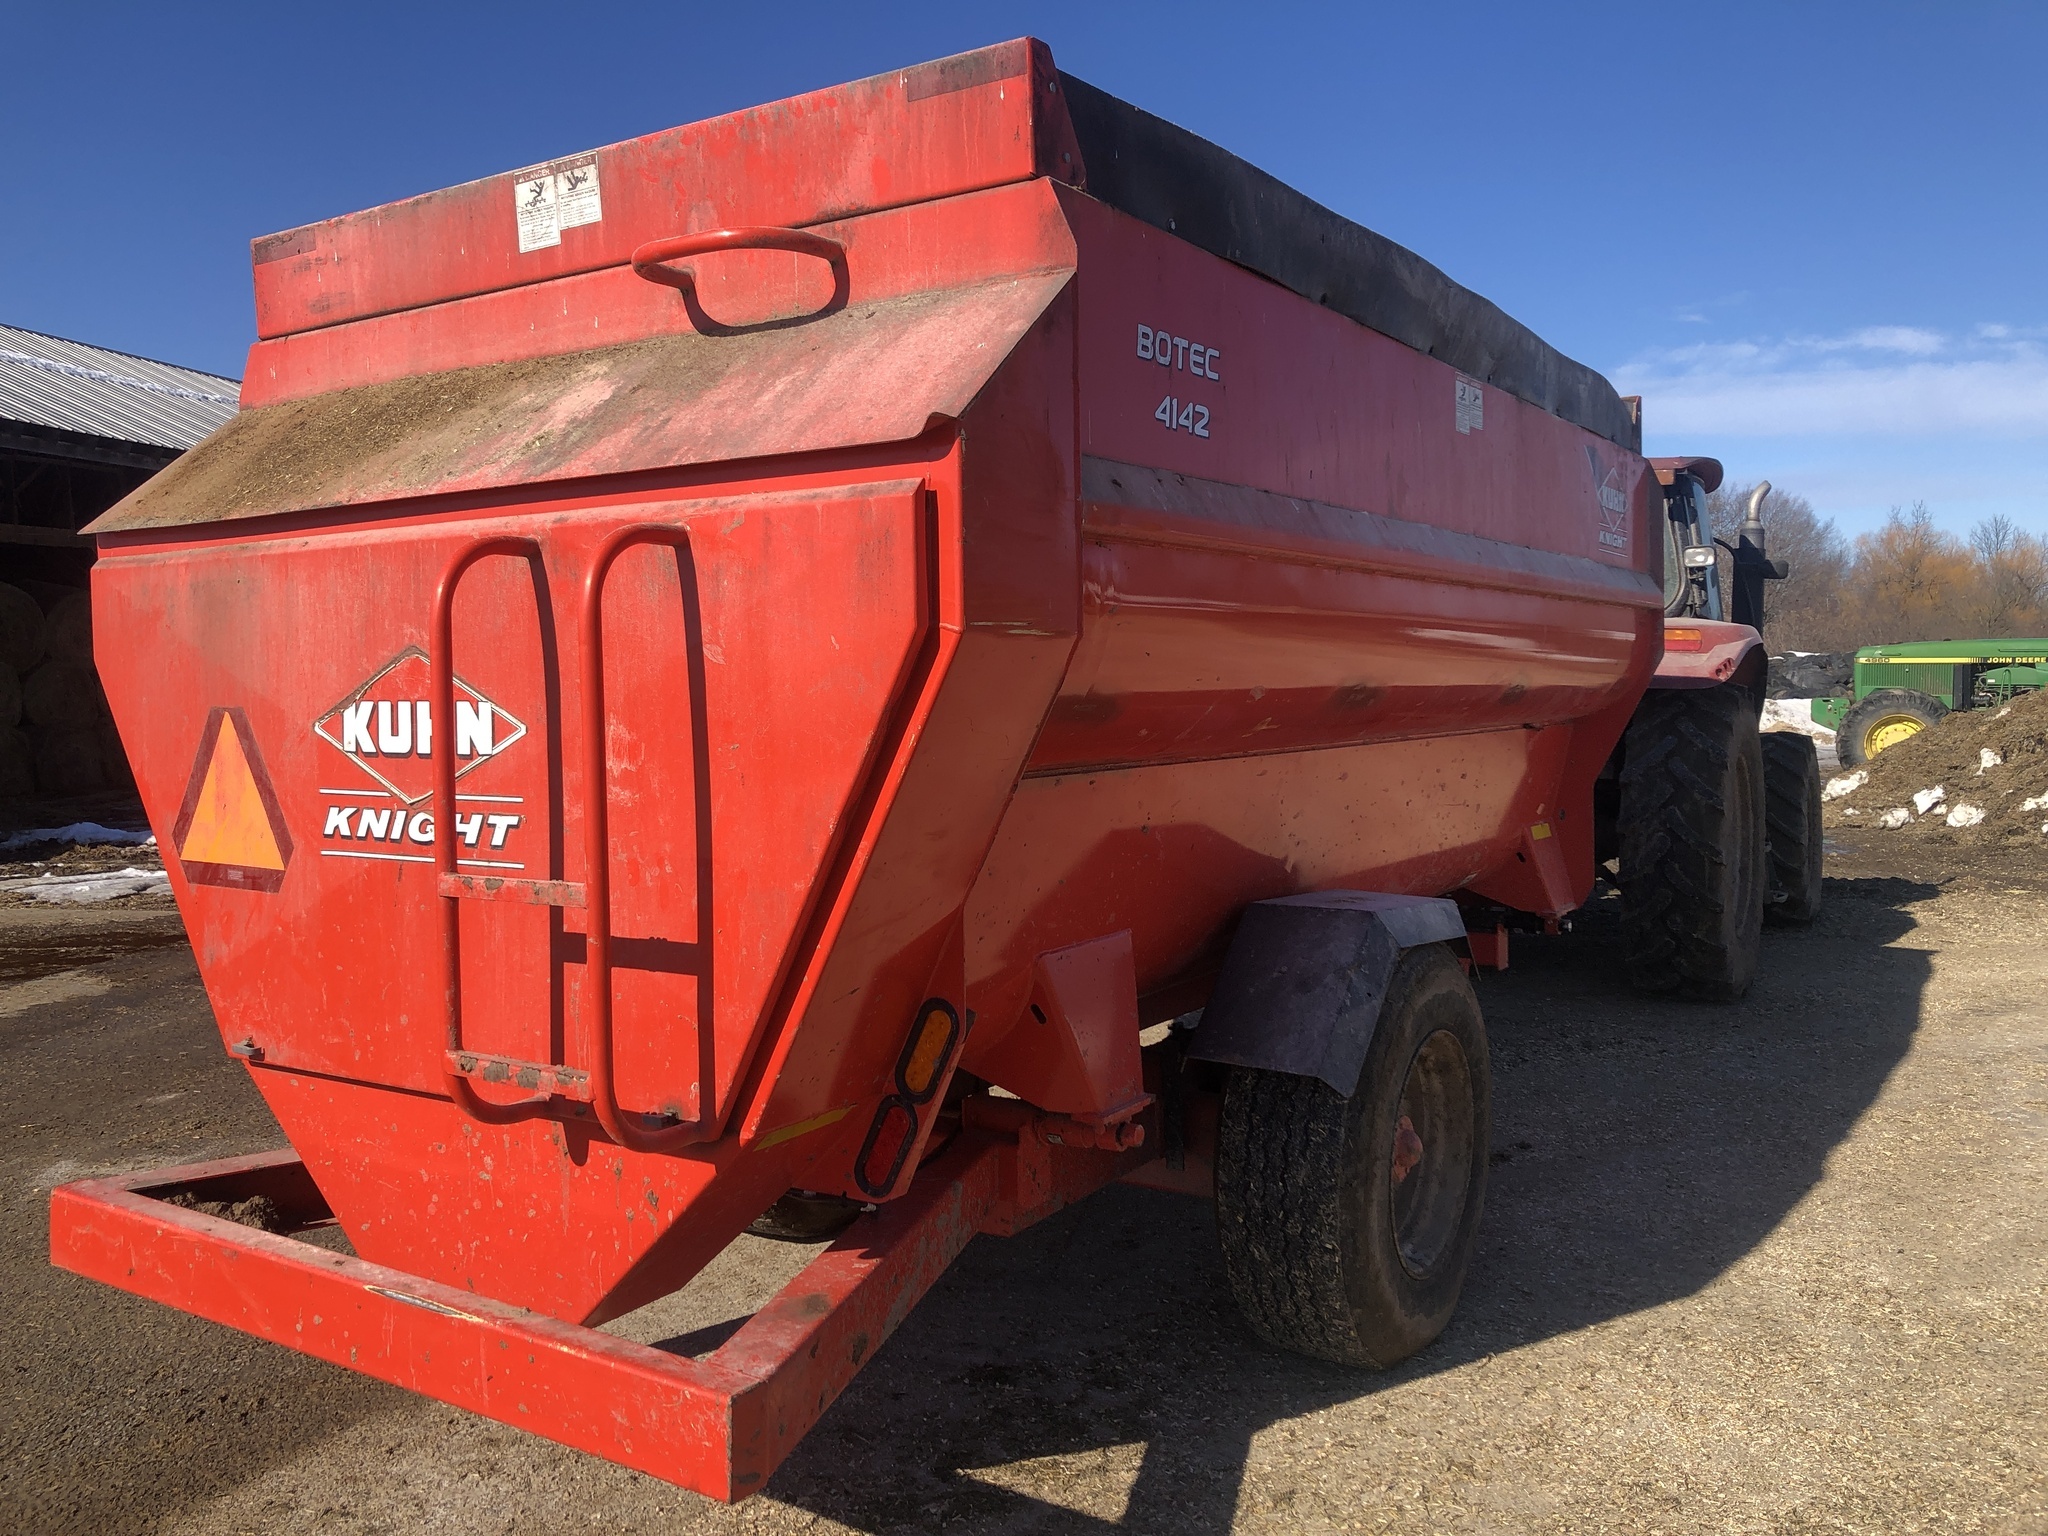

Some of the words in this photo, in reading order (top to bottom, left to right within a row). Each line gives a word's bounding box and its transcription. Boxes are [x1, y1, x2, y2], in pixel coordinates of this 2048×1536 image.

[1137, 323, 1220, 381] BOTEC
[1154, 395, 1210, 438] 4142
[1599, 530, 1628, 548] KNIGHT
[323, 806, 520, 849] KNIGHT
